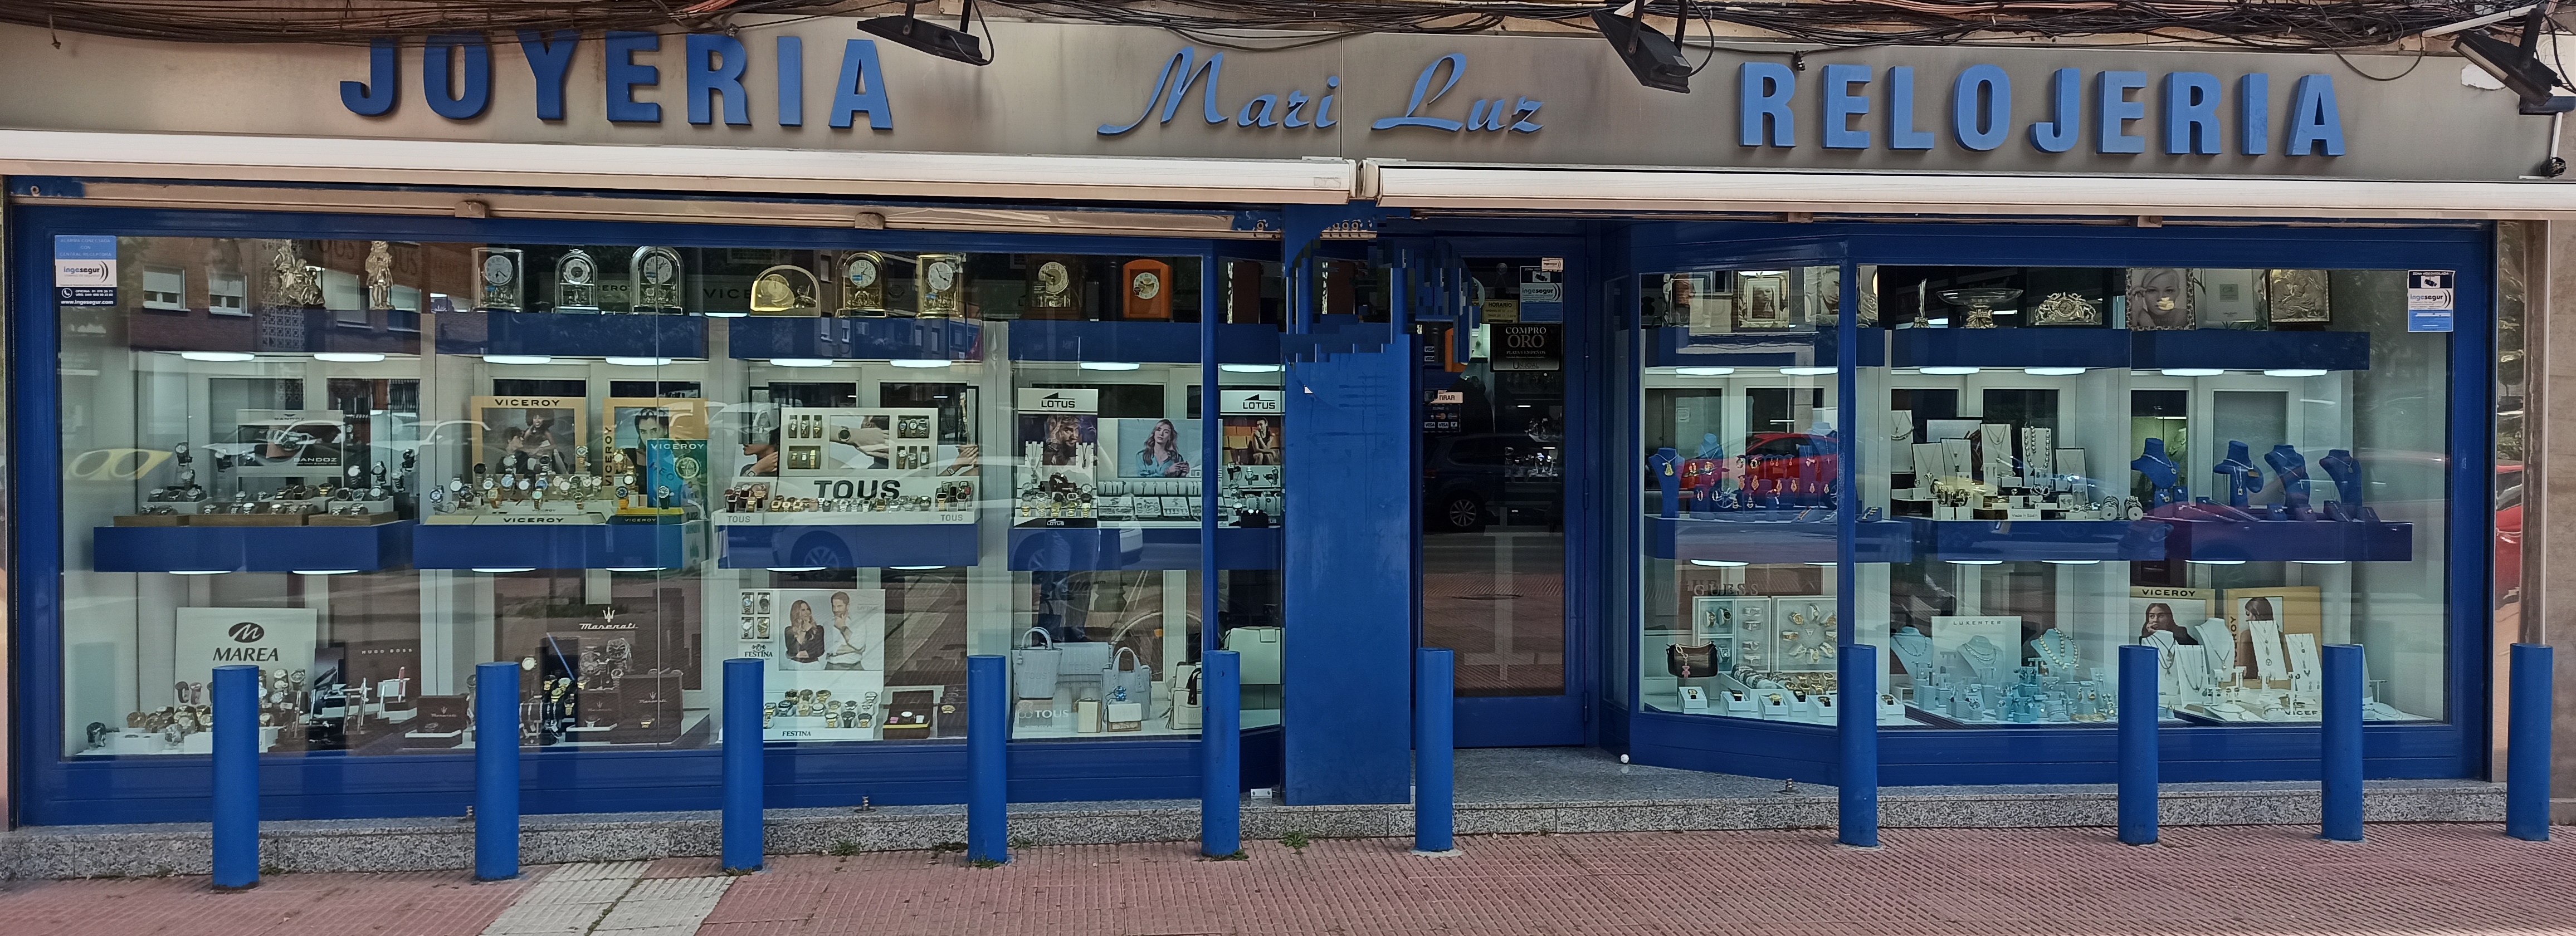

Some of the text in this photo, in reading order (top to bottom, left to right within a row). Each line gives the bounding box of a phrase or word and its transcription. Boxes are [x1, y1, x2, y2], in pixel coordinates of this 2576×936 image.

[339, 29, 892, 131] JOYERIA
[1096, 46, 1544, 136] Mari Luz
[1738, 61, 2346, 158] RELOJERIA
[64, 266, 100, 275] ingesegur
[1507, 334, 1545, 348] ORO
[1041, 400, 1075, 408] LOTUS
[604, 427, 613, 486] VICEROY
[813, 479, 901, 500] TOUS
[1694, 583, 1759, 596] GUESS
[2141, 589, 2196, 597] VICEROY
[212, 647, 279, 661] MAREA
[1034, 709, 1069, 718] TOUS
